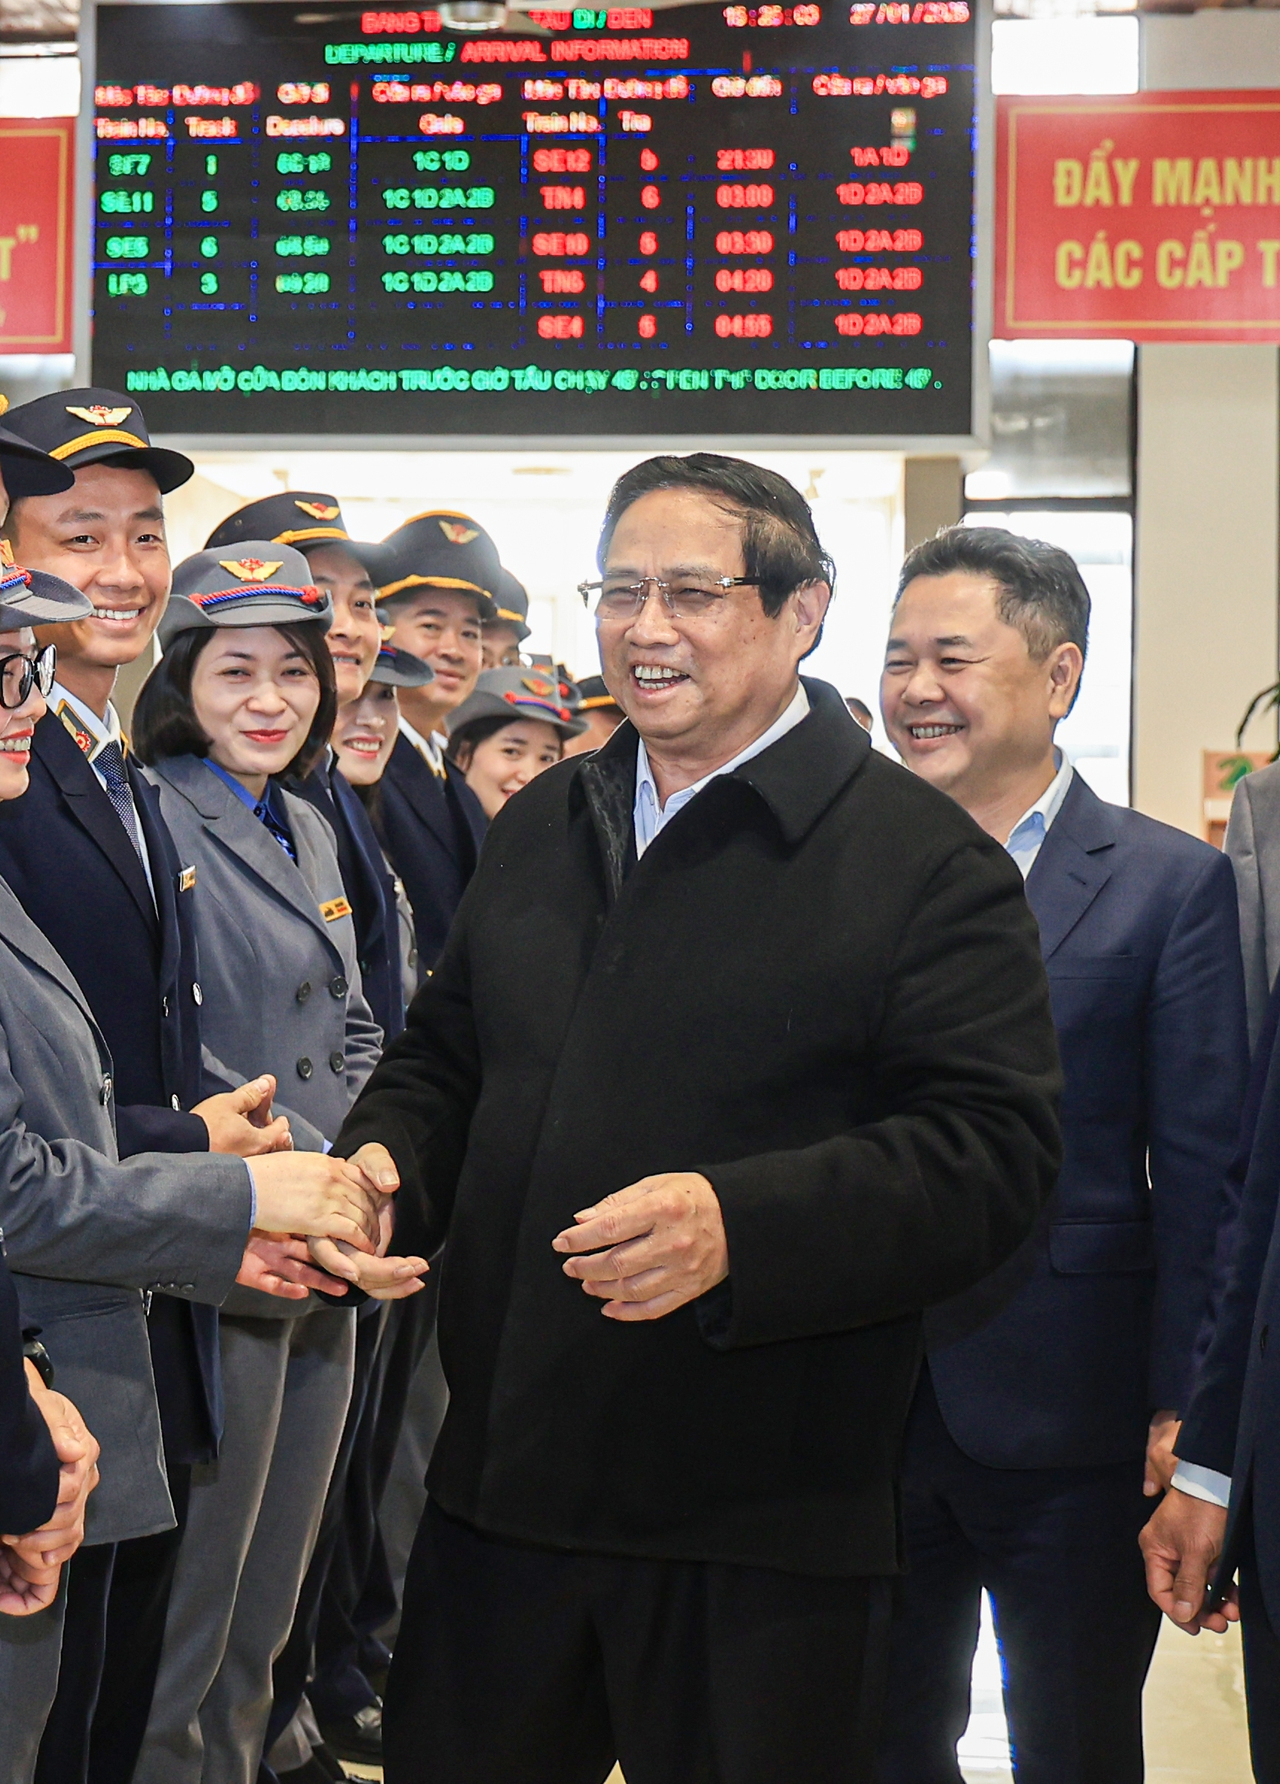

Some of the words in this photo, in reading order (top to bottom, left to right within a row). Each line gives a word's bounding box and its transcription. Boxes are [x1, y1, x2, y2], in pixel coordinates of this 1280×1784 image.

[460, 39, 548, 63] ARRIVAL
[551, 38, 690, 61] INFORMATION
[533, 148, 592, 172] SE12
[1152, 157, 1280, 217] MẠNH
[100, 190, 154, 213] SE11
[532, 232, 590, 256] SE10
[1055, 230, 1143, 289] CÁC
[1155, 222, 1244, 289] CẤP
[200, 272, 219, 295] 3
[639, 269, 659, 293] 4
